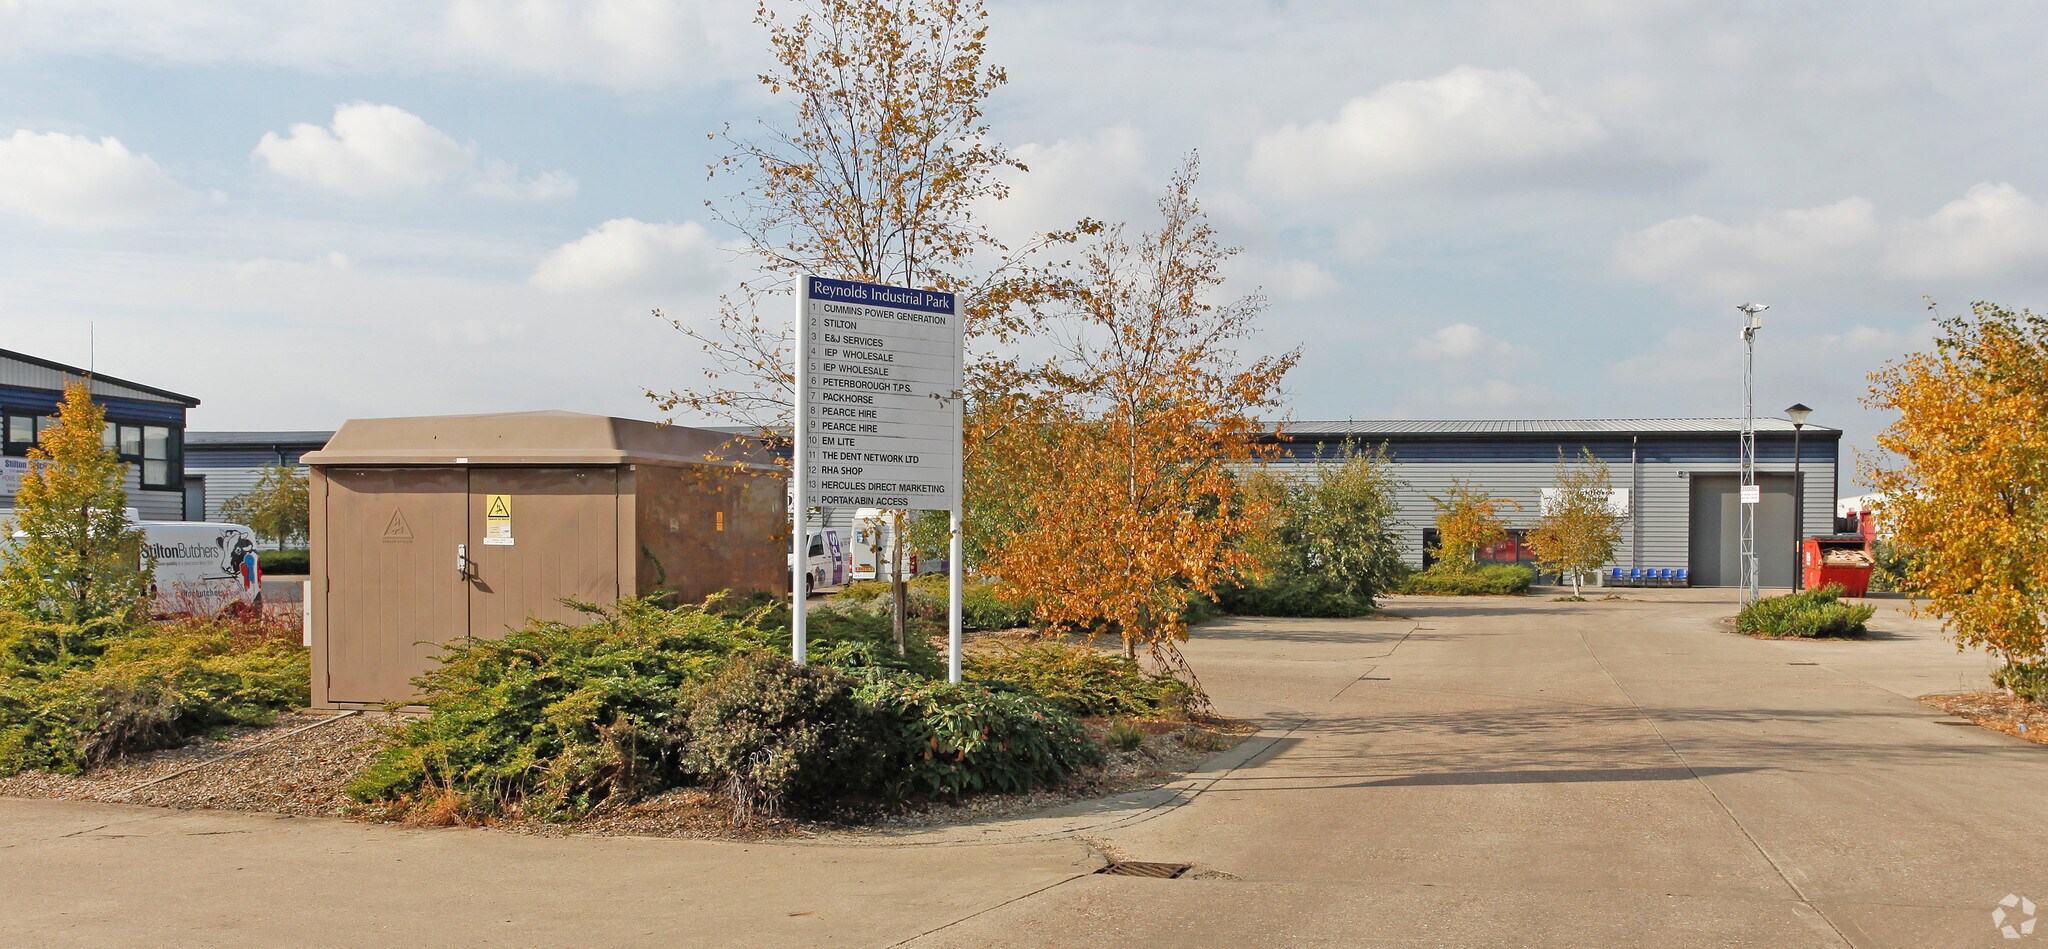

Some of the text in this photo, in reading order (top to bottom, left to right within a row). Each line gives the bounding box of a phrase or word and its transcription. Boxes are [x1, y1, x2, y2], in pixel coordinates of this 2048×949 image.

[814, 281, 950, 309] Reynolds Industrial Park
[811, 303, 946, 325] 1 CUMMINS POWER GENERATION
[811, 318, 857, 330] 2 STILTON
[811, 333, 884, 348] 3 E&J SERVICES
[824, 348, 838, 357] IEP
[842, 350, 894, 363] WHOLESALE
[823, 363, 836, 372] IEP
[838, 364, 889, 376] WHOLESALE
[811, 377, 817, 385] 6
[823, 378, 891, 391] PETERBOROUGH
[811, 392, 874, 404] 7 PACKHORSE
[810, 406, 877, 419] 8 PEARCE HIRE
[810, 421, 878, 433] 9 PEARCE HIRE
[808, 436, 855, 446] 10 EM LITE
[808, 450, 919, 464] 11 THE DENT NETWORK LTD
[5, 459, 27, 469] Stilton
[808, 466, 863, 476] 12 RHA SHOP
[808, 480, 945, 493] 13 HERCULES DIRECT MARKETING
[808, 495, 909, 506] 14 PORTAKABIN ACCESS
[829, 532, 841, 571] TPS
